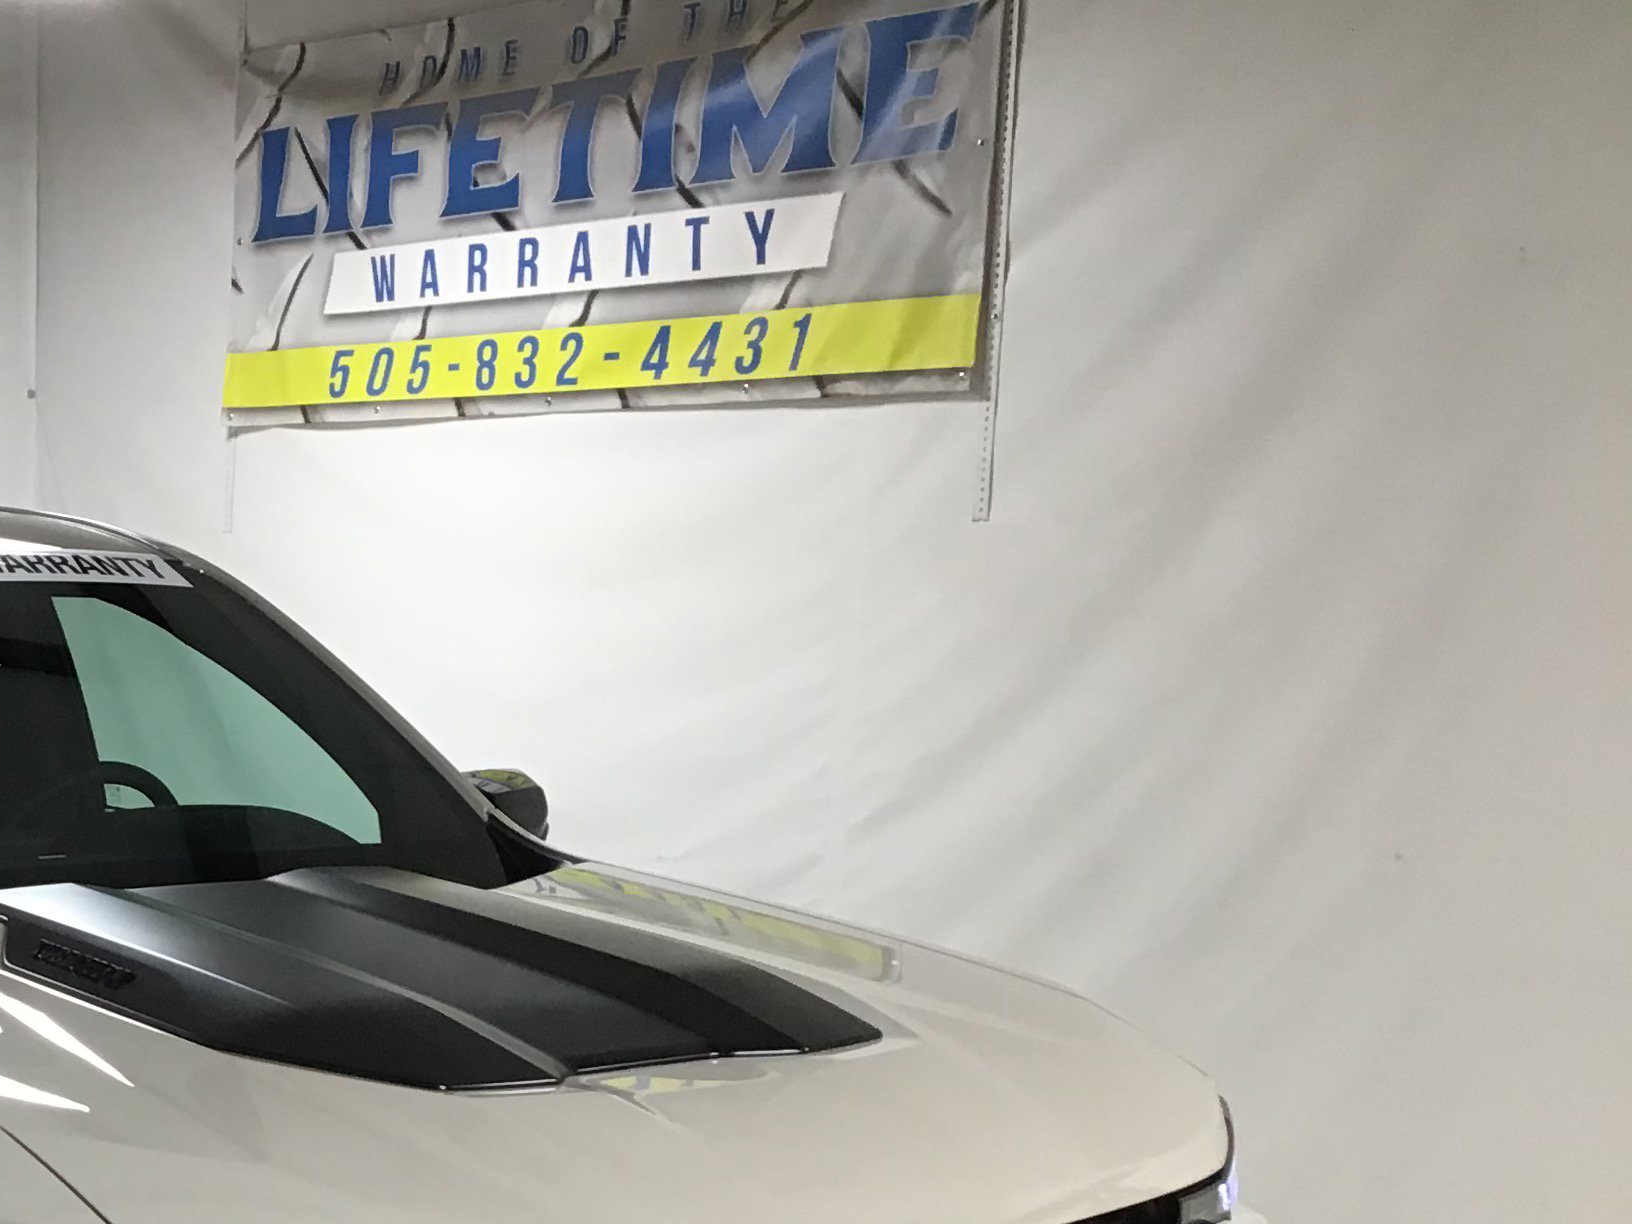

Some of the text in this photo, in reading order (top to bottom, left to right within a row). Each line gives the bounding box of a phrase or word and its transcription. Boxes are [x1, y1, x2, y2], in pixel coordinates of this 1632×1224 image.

[378, 38, 519, 96] HOME
[569, 16, 629, 65] OF
[251, 4, 972, 244] LIFETIME
[370, 208, 776, 305] WARRANTY
[328, 313, 814, 399] 505-832-4431
